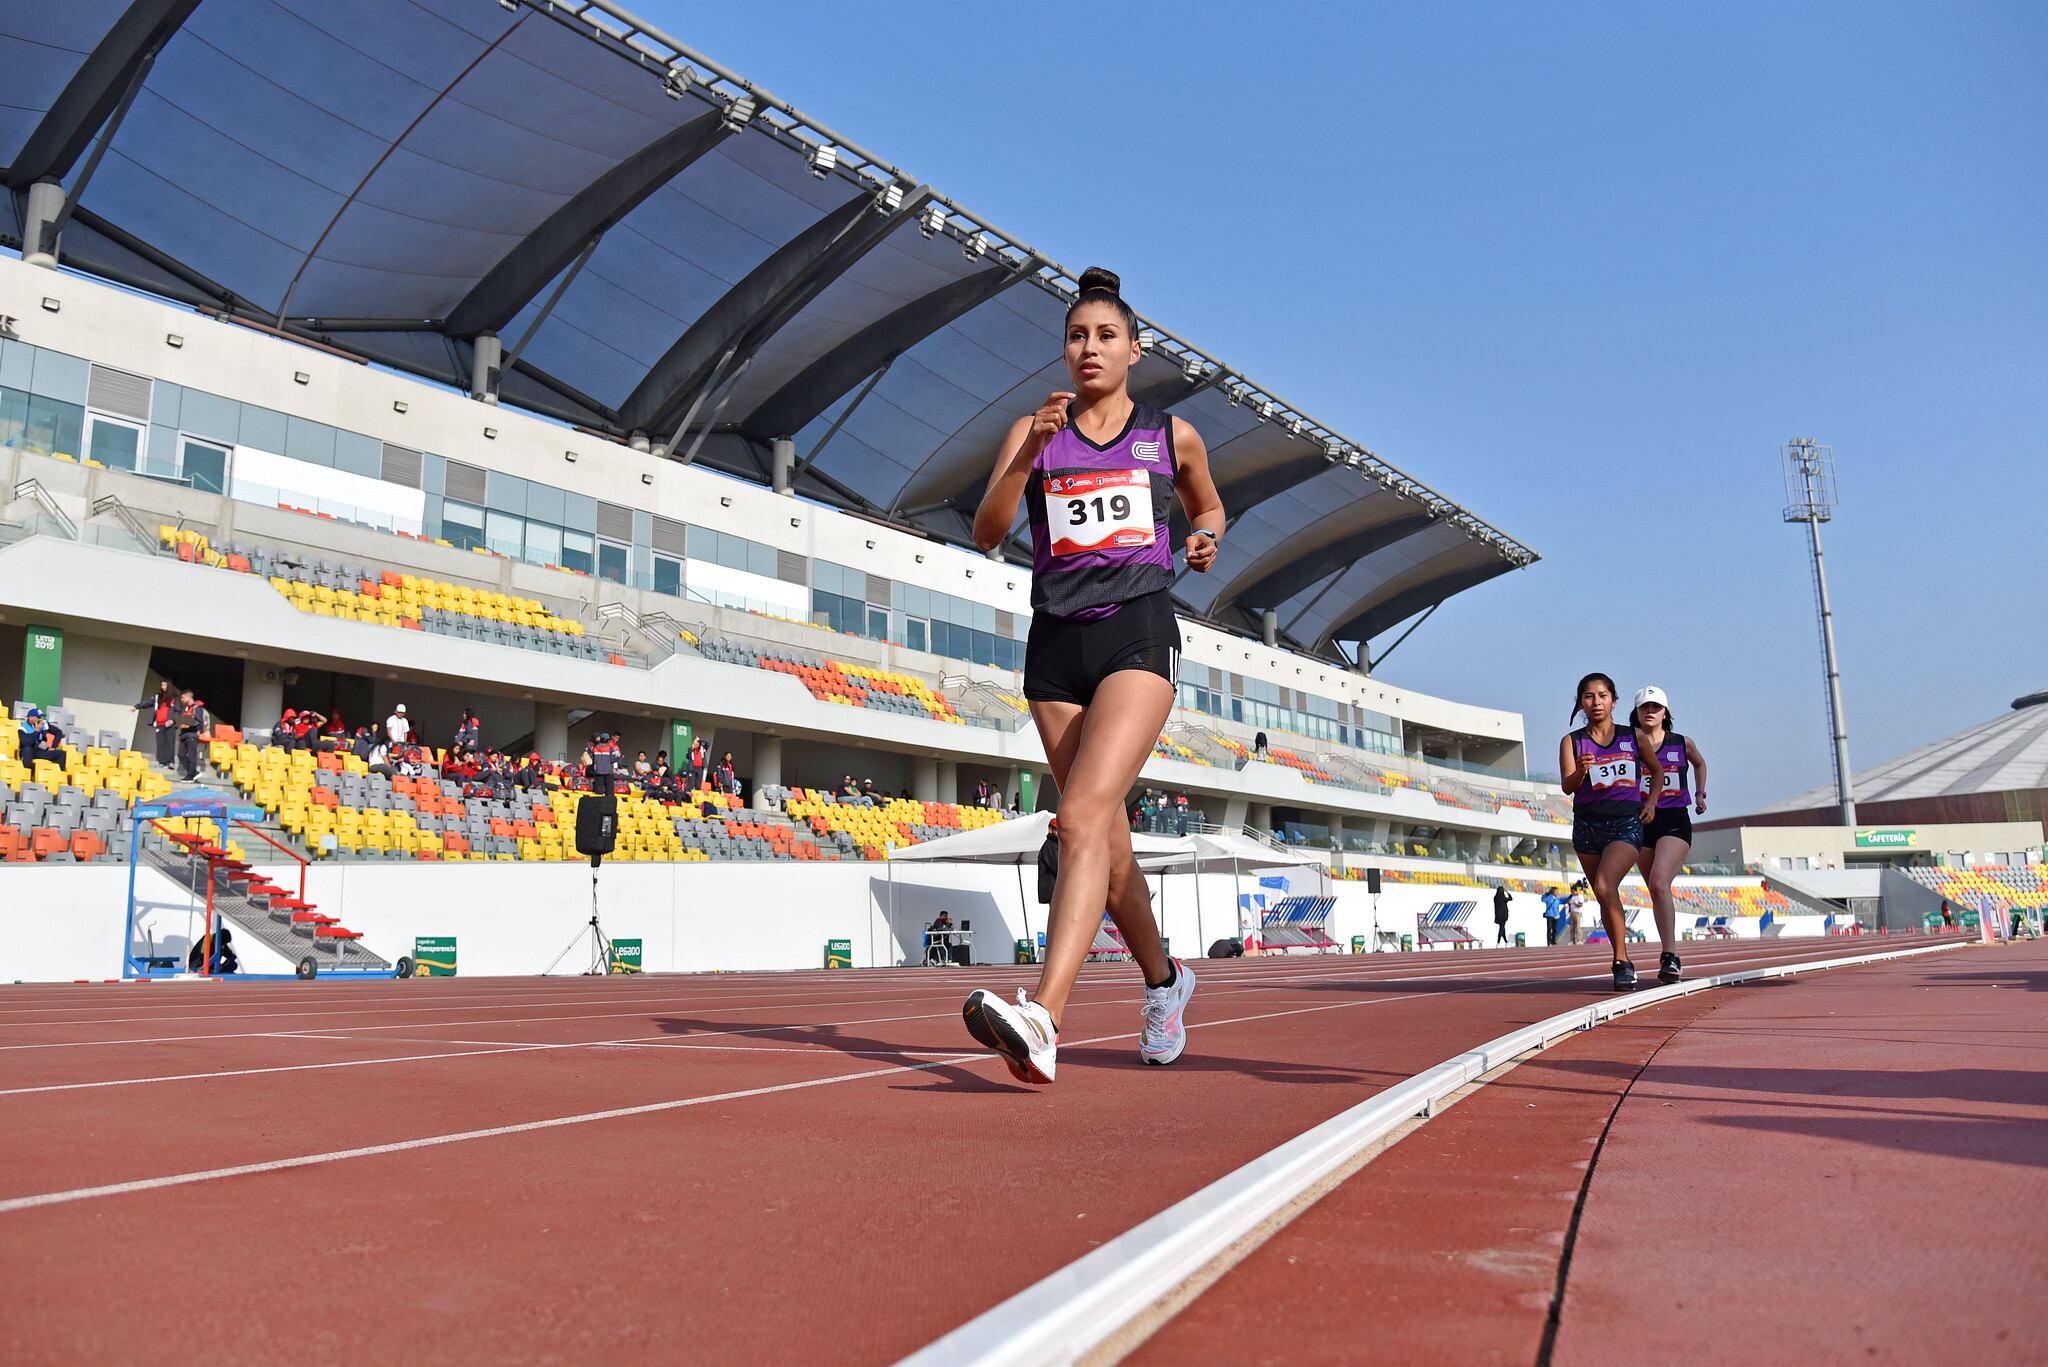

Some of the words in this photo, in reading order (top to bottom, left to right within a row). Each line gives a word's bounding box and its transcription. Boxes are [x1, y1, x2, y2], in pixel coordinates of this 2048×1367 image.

[1067, 495, 1131, 526] 319
[34, 641, 55, 650] 2019
[1599, 763, 1627, 778] 318
[1644, 775, 1671, 788] 30
[1867, 833, 1906, 843] CAFETERÍA
[417, 945, 456, 953] Transparencia
